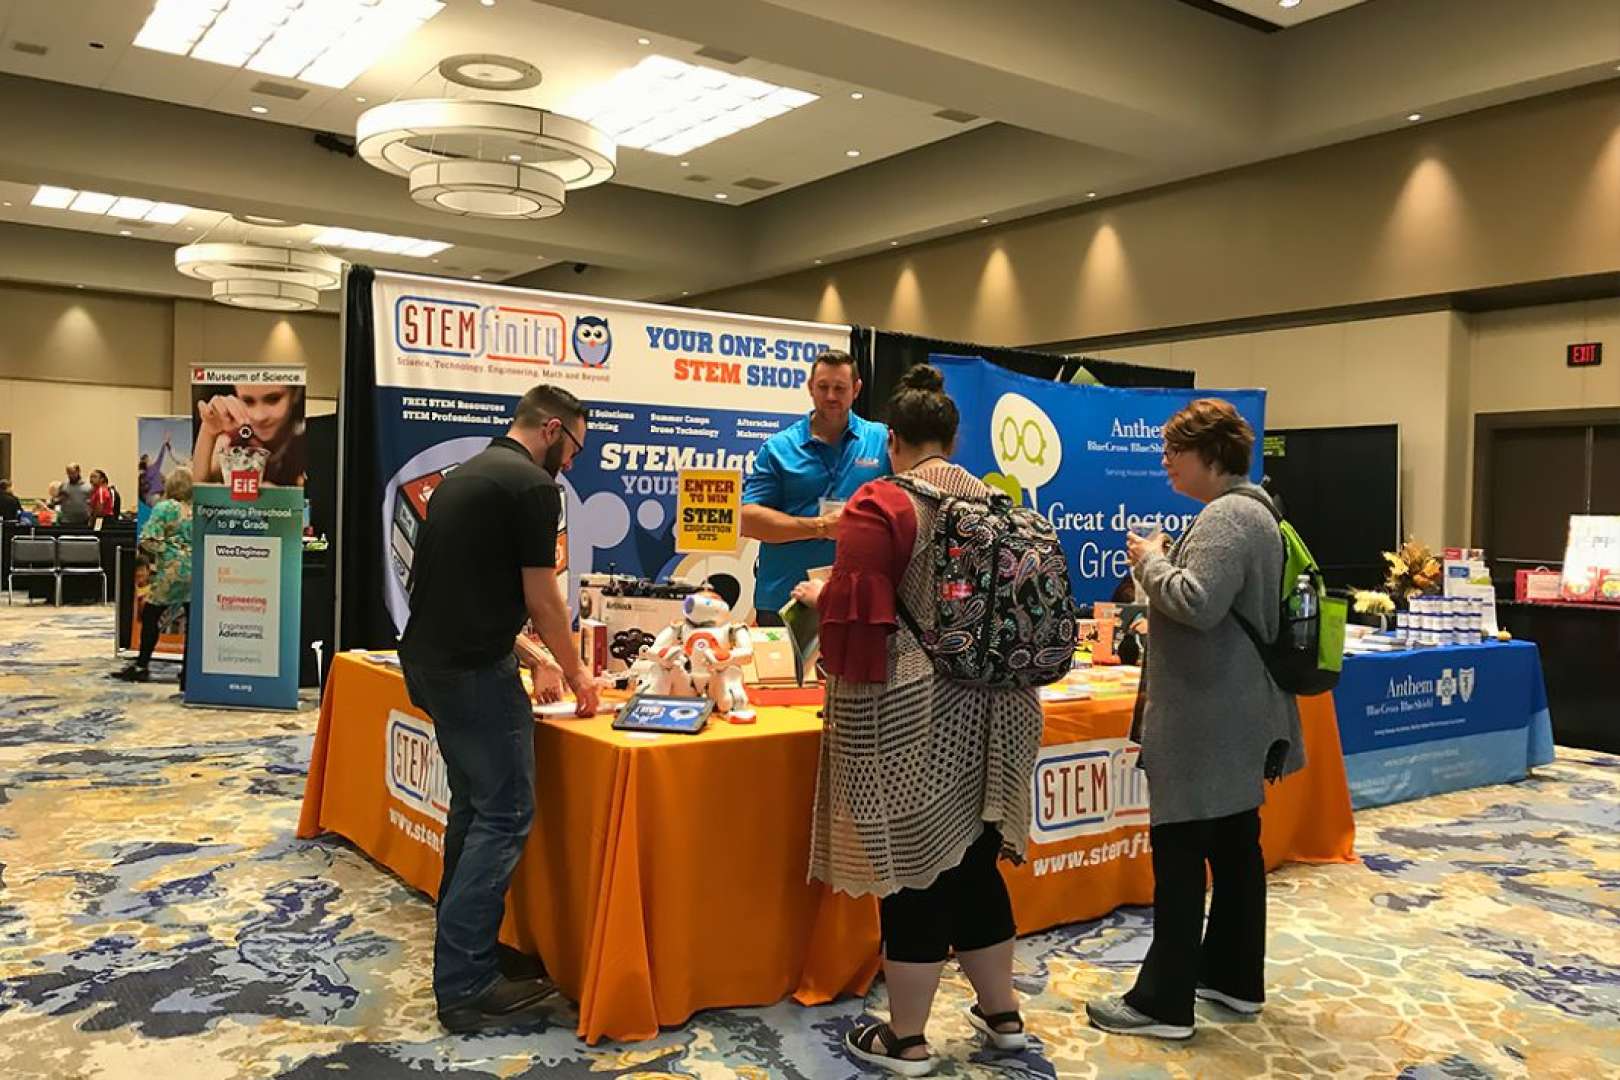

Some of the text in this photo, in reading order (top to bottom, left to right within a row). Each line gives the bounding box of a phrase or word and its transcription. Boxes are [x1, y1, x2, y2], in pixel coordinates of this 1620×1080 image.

[404, 304, 562, 366] STEMfinity
[646, 326, 713, 353] YOUR
[1573, 345, 1596, 362] EXIT
[206, 371, 300, 382] Museum of Science
[542, 370, 562, 379] Math
[565, 372, 579, 380] and
[674, 358, 807, 389] STEM SHOP
[403, 396, 505, 412] FREE STEM Resources
[403, 410, 429, 420] STEM
[432, 411, 491, 424] Professional
[651, 413, 710, 426] Summer Camps
[736, 418, 780, 429] Afterschool
[651, 425, 719, 439] Drone Technology
[1087, 440, 1129, 451] BlueCross
[600, 443, 756, 475] STEMulat
[233, 479, 257, 493] EiE
[684, 479, 735, 493] ENTER
[689, 493, 728, 503] TO WIN
[198, 505, 292, 519] Engineering Preschool
[682, 508, 733, 524] STEM
[1048, 502, 1199, 533] Great doctor
[218, 520, 227, 529] to
[242, 520, 269, 530] Grade
[684, 524, 731, 533] EDUCATION
[697, 533, 718, 541] KITS
[1080, 542, 1128, 579] Gre
[217, 594, 267, 607] Engineering
[1387, 675, 1434, 699] Anthem
[396, 731, 448, 803] STEMfin
[1043, 749, 1142, 822] STEMfin
[1033, 831, 1153, 877] www.stemfi
